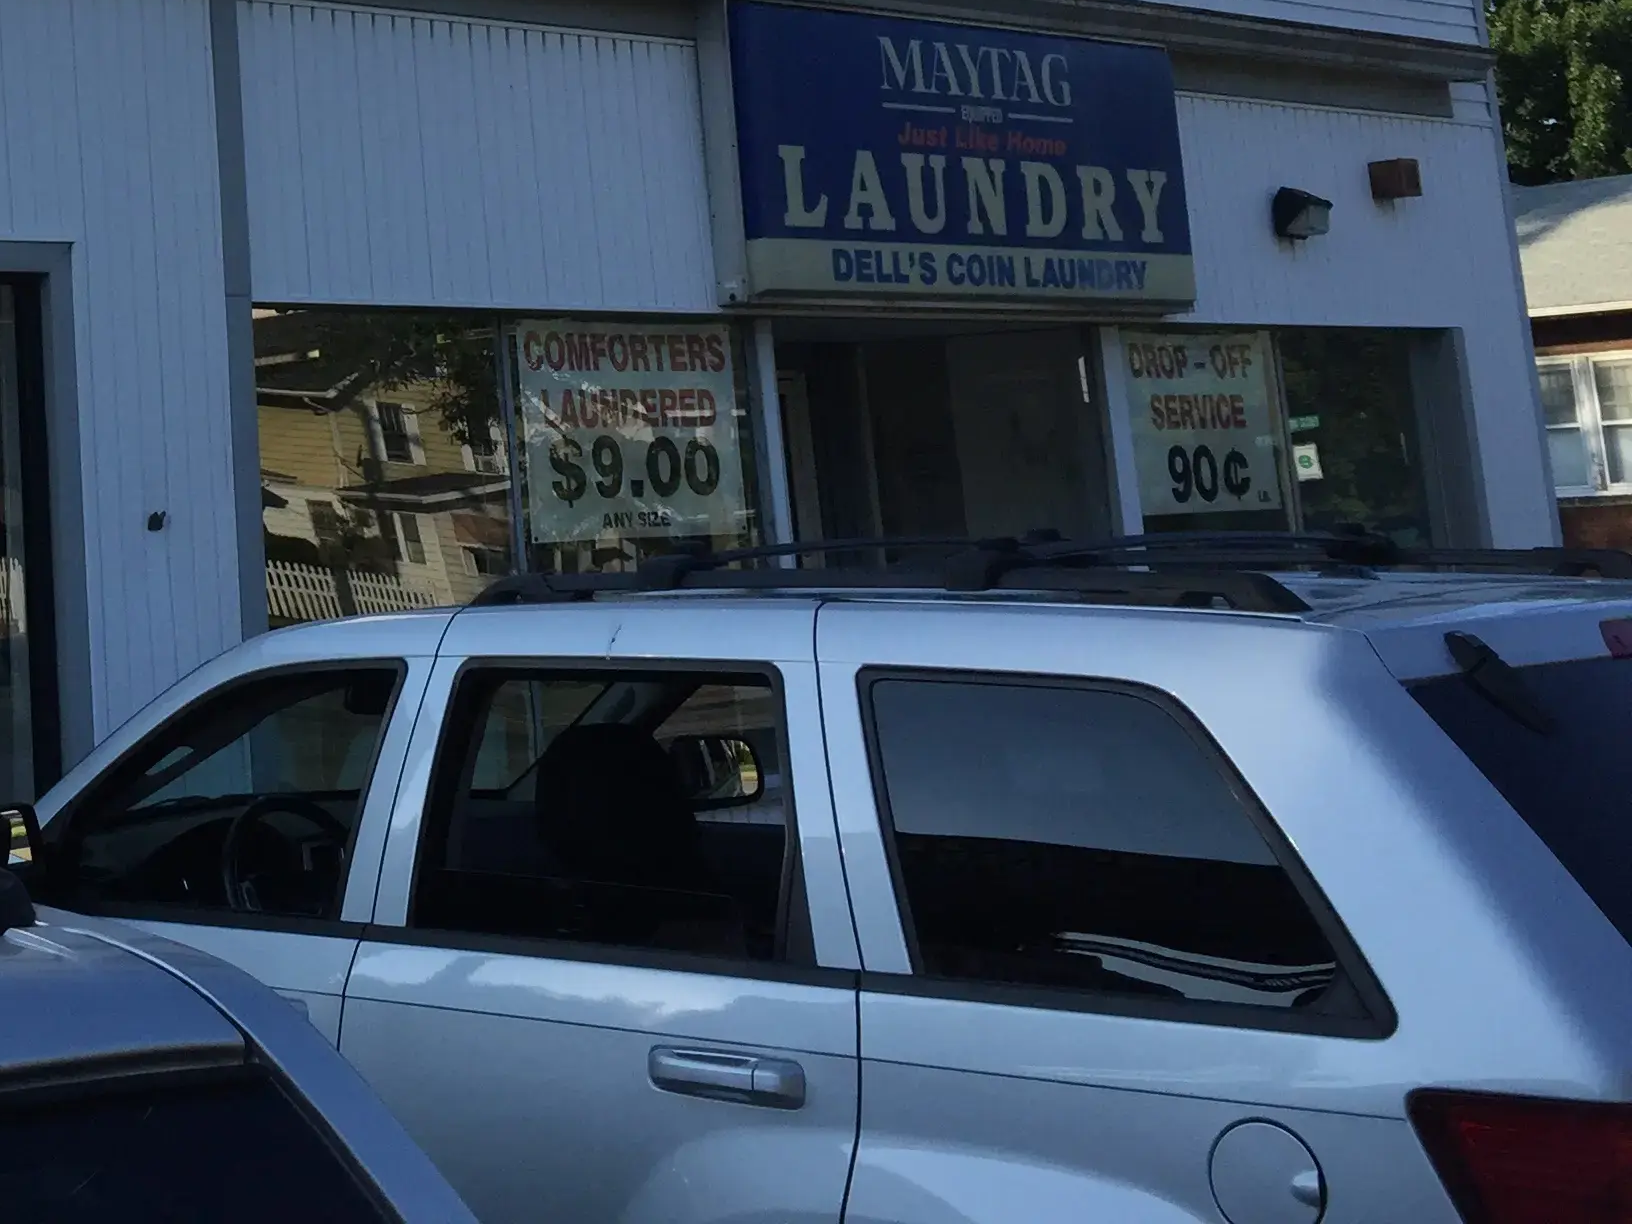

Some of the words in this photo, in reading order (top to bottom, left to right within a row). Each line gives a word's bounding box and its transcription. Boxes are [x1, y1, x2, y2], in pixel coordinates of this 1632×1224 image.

[876, 36, 1072, 107] MAYTAG
[898, 122, 948, 147] Just
[955, 125, 999, 152] Like
[1007, 130, 1067, 156] Home
[778, 144, 1167, 244] LAUNDRY
[831, 247, 938, 285] DELL'S
[946, 253, 1016, 288] COIN
[1023, 255, 1147, 291] LAUNDRY
[523, 331, 726, 372] COMFORTERS
[540, 388, 717, 428] LAUNDERED
[1150, 393, 1248, 431] SERVICE
[549, 433, 720, 509] $9.00
[602, 511, 633, 529] ANY
[637, 510, 671, 527] SIZE
